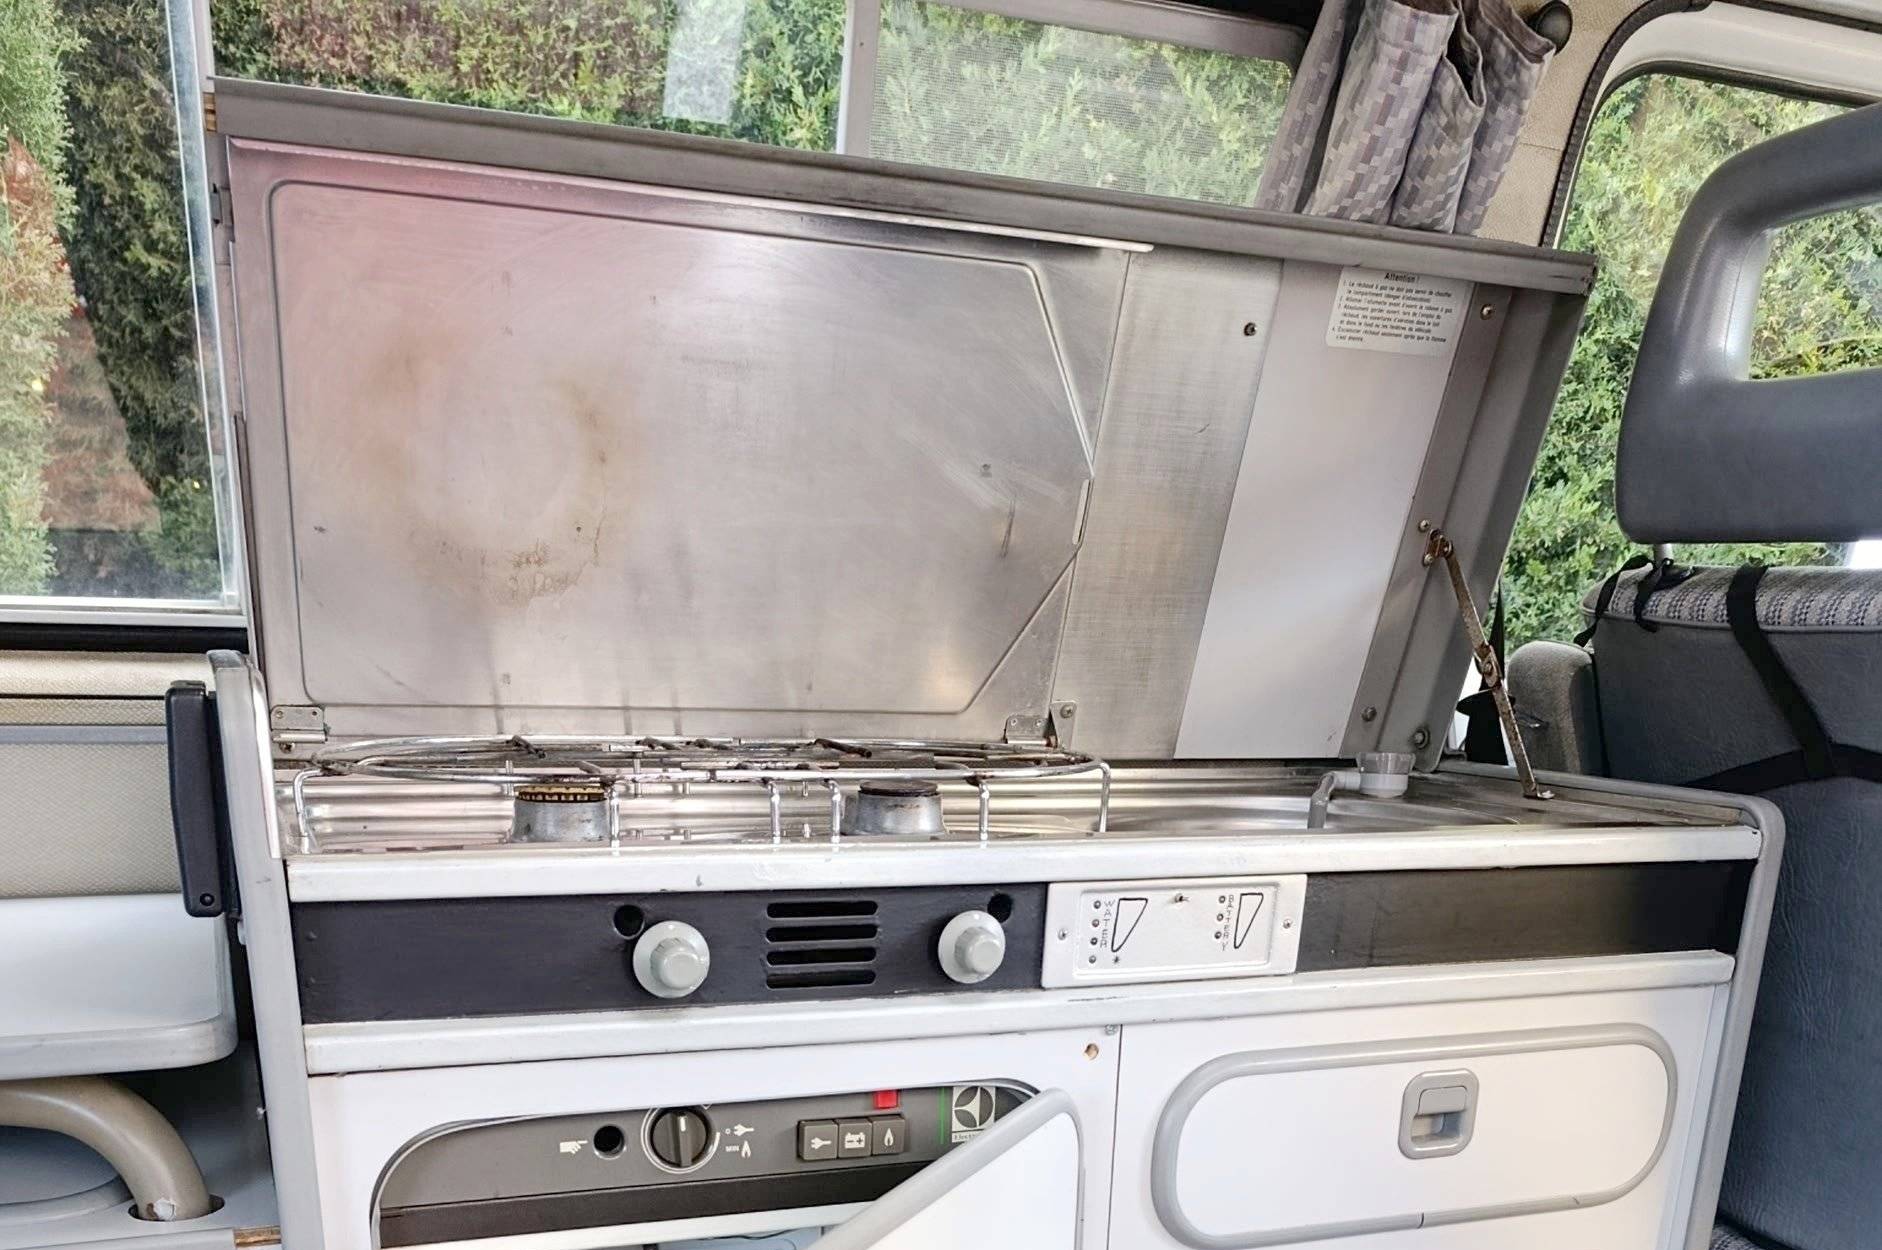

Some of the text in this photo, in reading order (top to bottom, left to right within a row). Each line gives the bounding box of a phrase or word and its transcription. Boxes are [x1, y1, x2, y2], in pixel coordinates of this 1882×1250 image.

[1383, 272, 1415, 283] Attention
[1100, 899, 1116, 949] WATER
[1222, 894, 1235, 951] BATTERY
